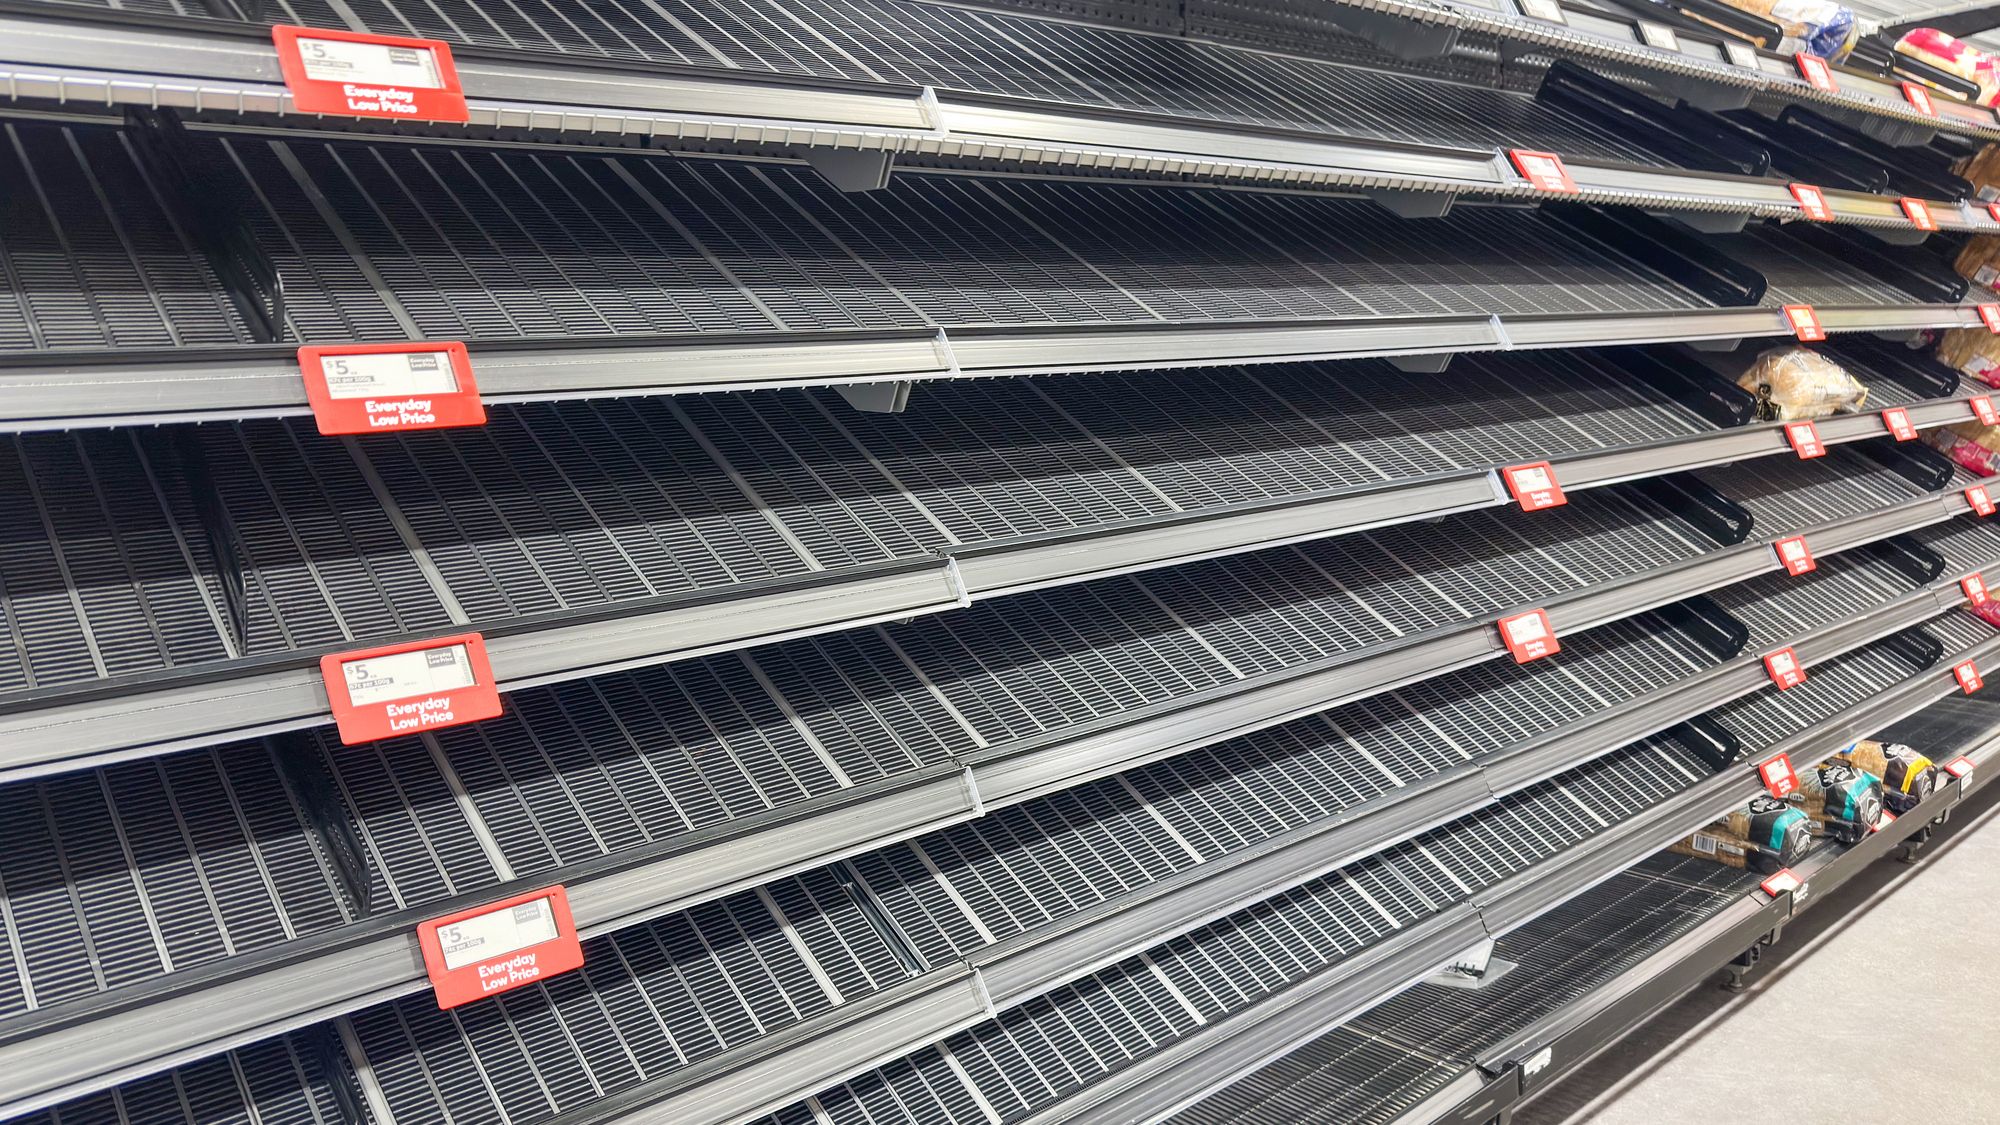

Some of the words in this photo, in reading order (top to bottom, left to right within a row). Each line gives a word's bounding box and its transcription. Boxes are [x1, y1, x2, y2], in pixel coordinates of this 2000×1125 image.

[343, 85, 414, 103] Everyday
[348, 98, 379, 111] Low
[381, 100, 417, 114] Price
[365, 398, 431, 414] Everyday
[369, 414, 399, 427] Low
[401, 412, 435, 425] Price
[386, 697, 450, 717] Everyday
[390, 718, 419, 731] Low
[421, 711, 454, 726] Price
[478, 953, 536, 978] Everyday
[482, 978, 508, 992] Low
[510, 966, 540, 982] Price
